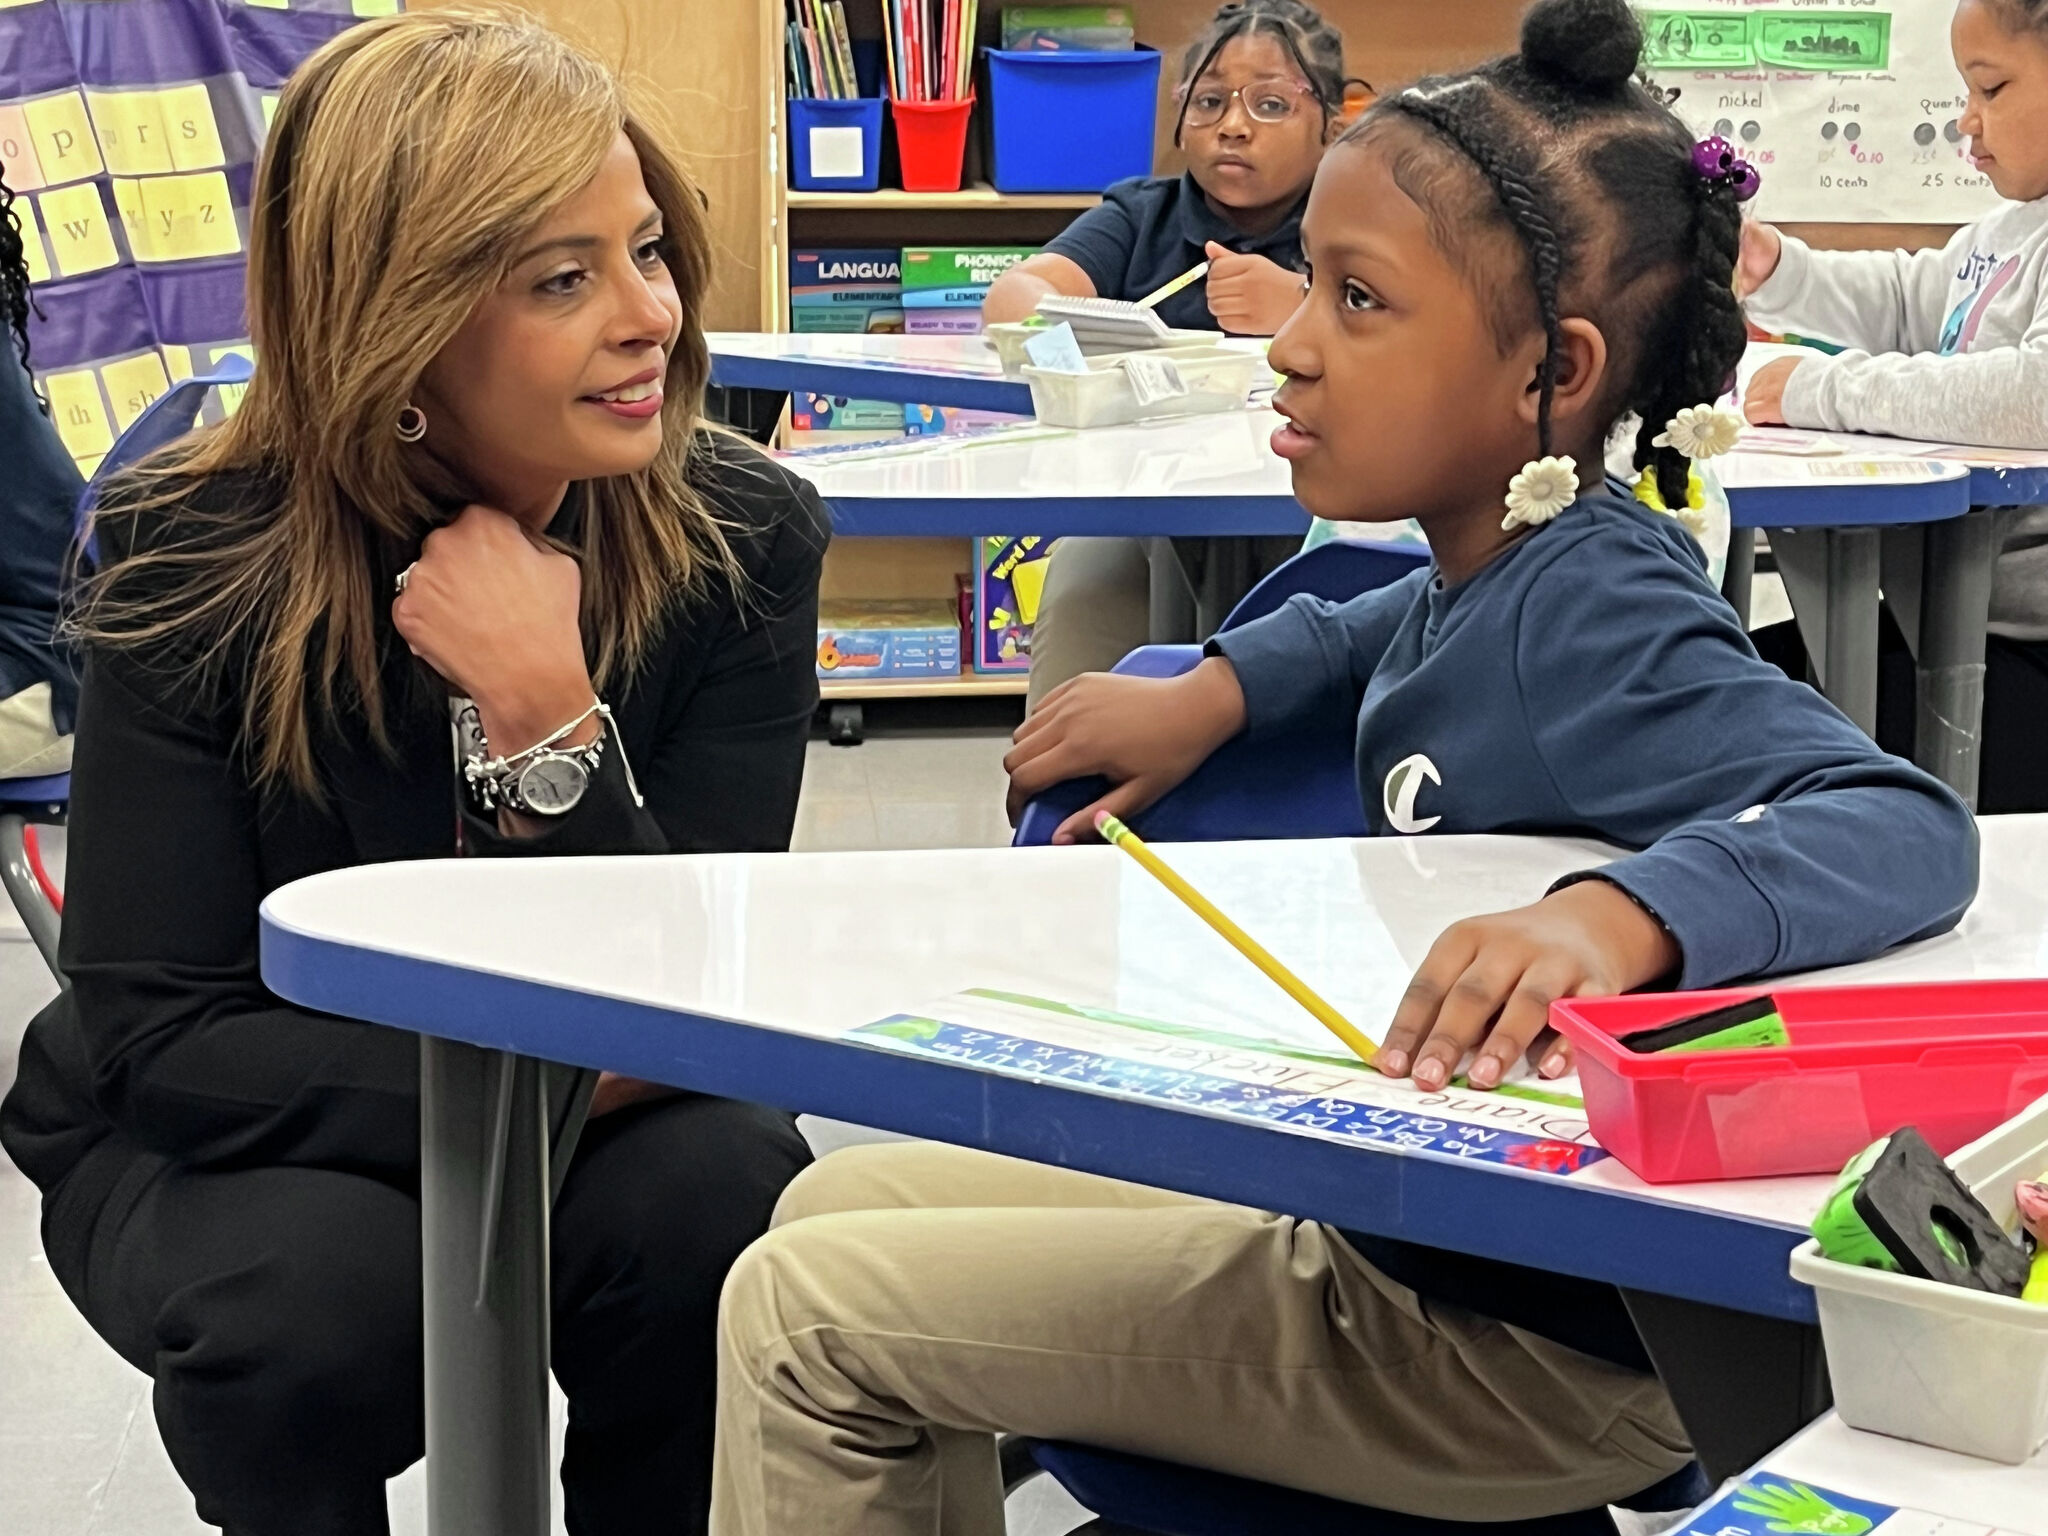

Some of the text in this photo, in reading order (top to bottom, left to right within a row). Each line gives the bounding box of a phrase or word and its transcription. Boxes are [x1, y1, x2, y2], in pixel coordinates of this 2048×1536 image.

[1718, 91, 1763, 108] nickel
[1827, 98, 1861, 113] dime
[2, 138, 19, 158] o
[51, 129, 74, 158] p
[137, 124, 149, 143] r
[181, 119, 198, 140] s
[1819, 175, 1868, 188] 10 cents
[1921, 172, 1944, 187] 25
[63, 218, 90, 241] w
[160, 208, 174, 236] y
[200, 204, 215, 224] z
[68, 404, 92, 426] th
[1418, 1093, 1590, 1142] Diane
